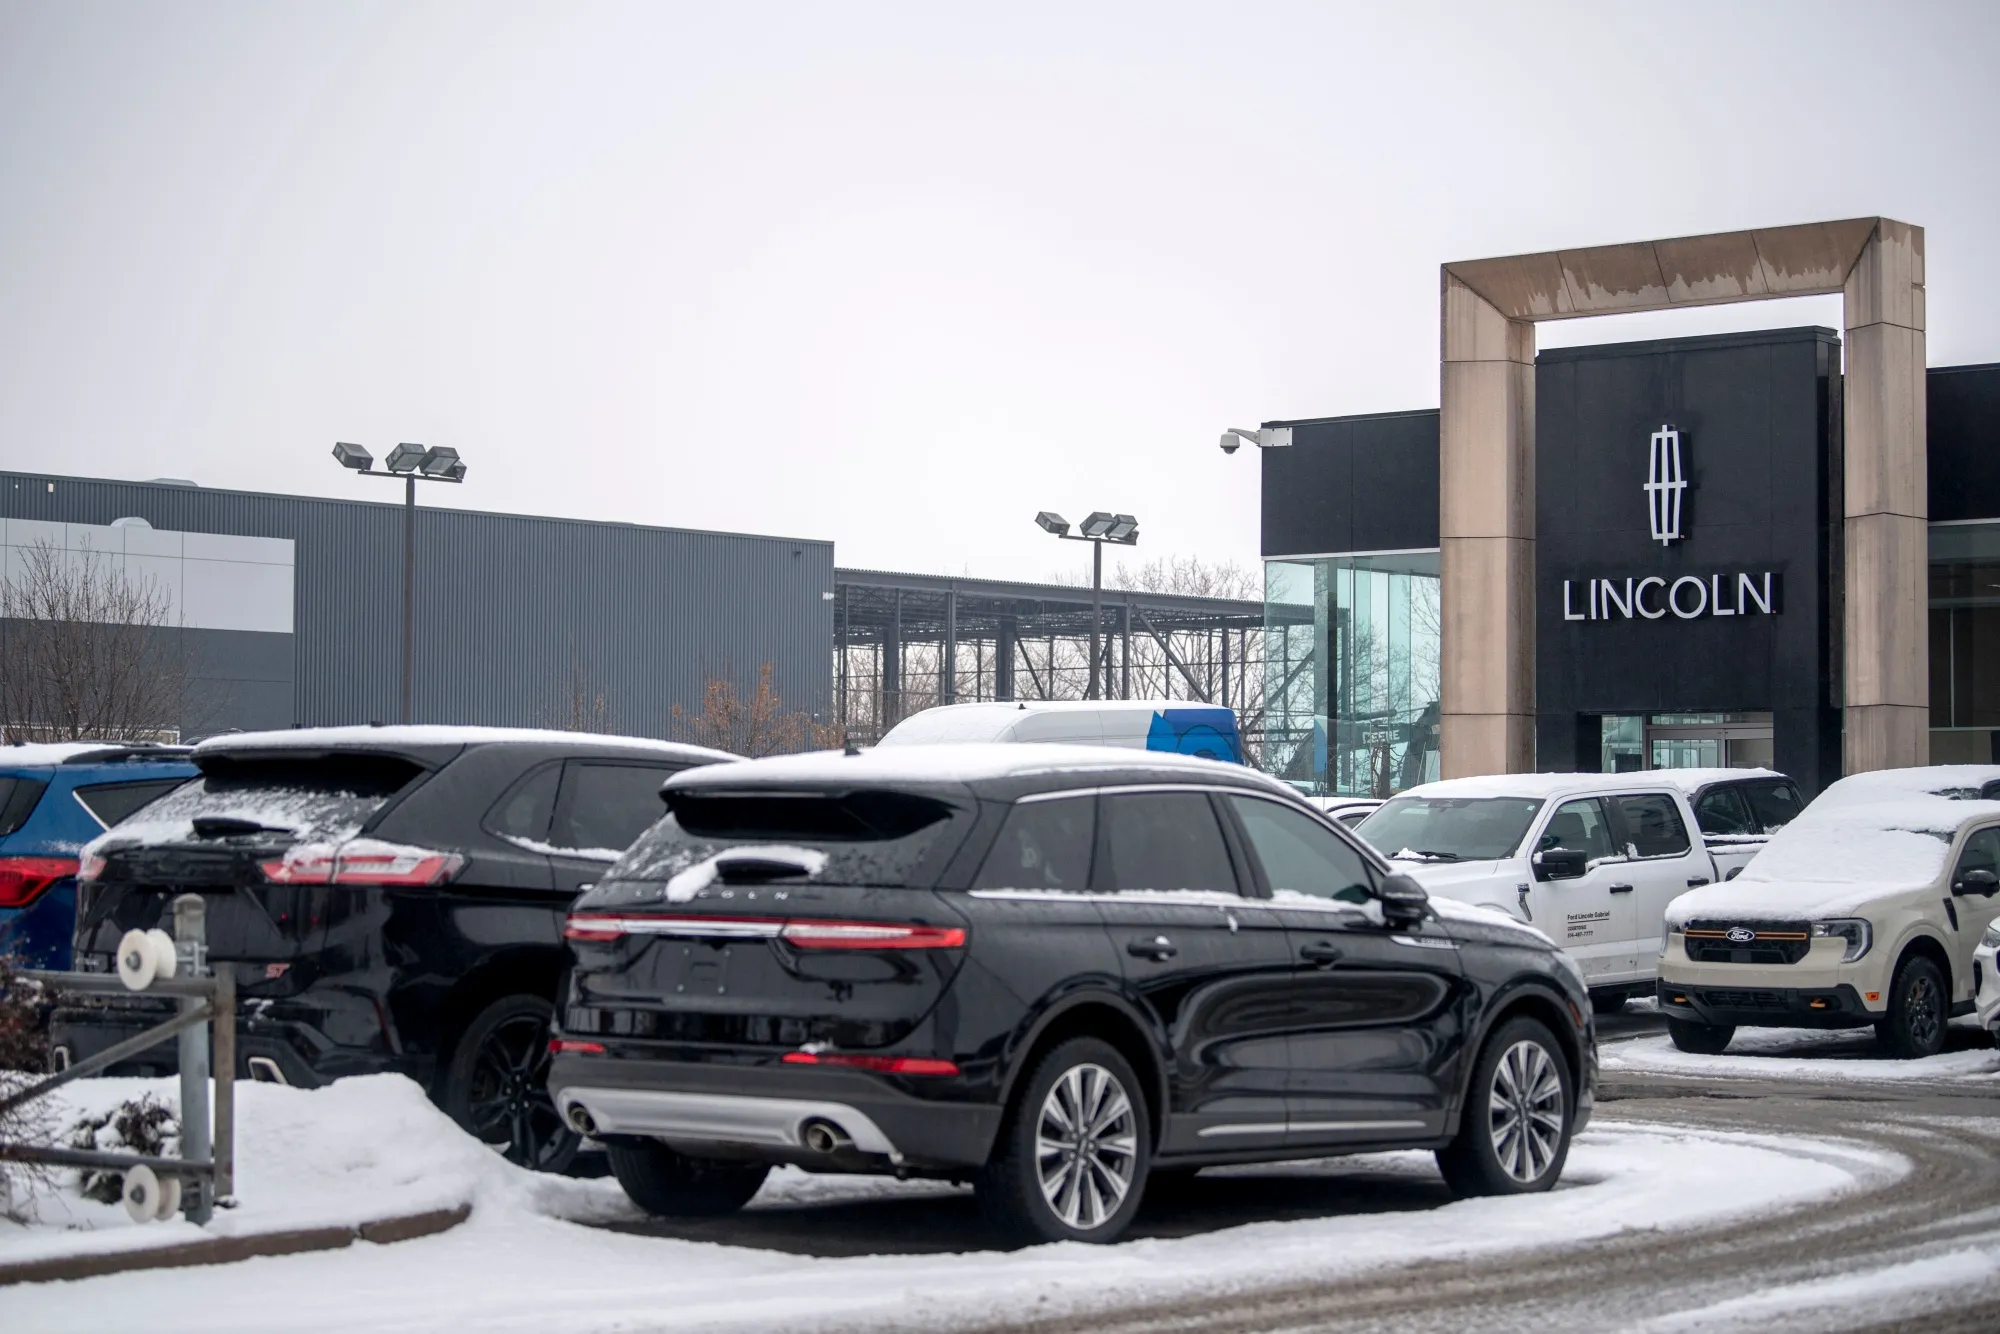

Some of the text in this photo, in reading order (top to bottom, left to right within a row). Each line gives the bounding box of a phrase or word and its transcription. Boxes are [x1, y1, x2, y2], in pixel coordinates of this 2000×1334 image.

[1564, 572, 1771, 620] LINCOLN
[635, 888, 789, 900] LICOLN
[1578, 911, 1593, 919] Lincoln
[265, 963, 290, 978] ST
